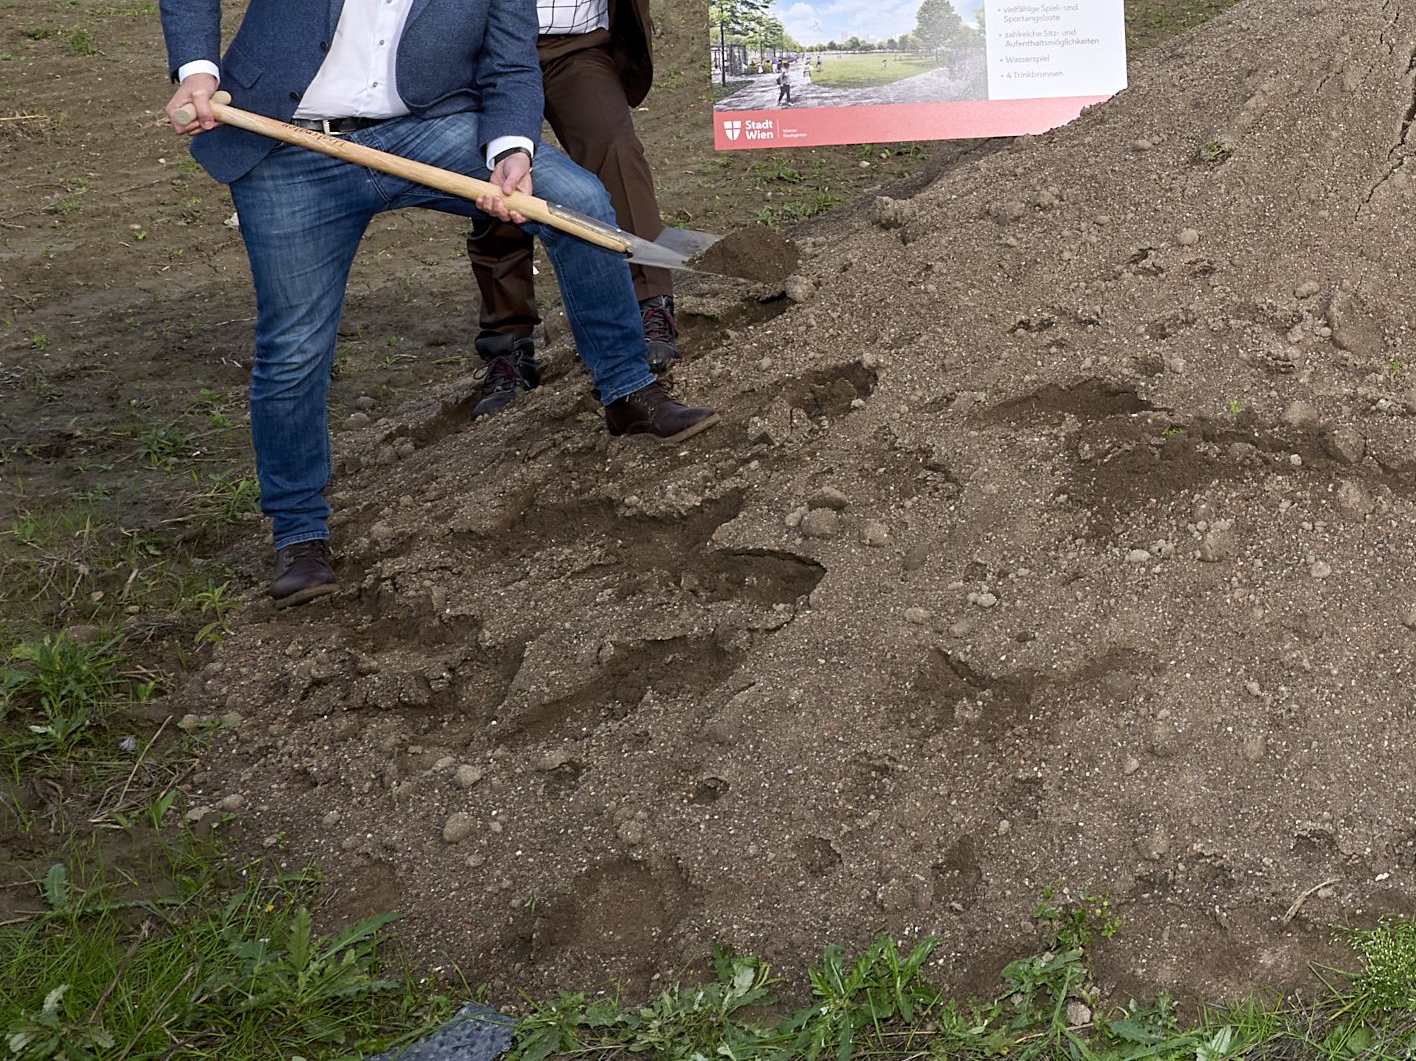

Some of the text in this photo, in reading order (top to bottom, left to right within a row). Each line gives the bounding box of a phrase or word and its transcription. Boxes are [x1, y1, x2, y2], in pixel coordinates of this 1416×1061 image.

[1003, 5, 1040, 15] vielfältige
[1041, 4, 1061, 14] Spiel-
[1003, 14, 1061, 24] Sportangebote
[1004, 29, 1042, 38] zahlreiche
[1043, 29, 1060, 37] Sitz-
[1004, 37, 1100, 48] Aufenthaltsmöglichkeiten
[1005, 55, 1050, 64] Wasserspiel
[1013, 70, 1064, 79] Trinkbrunnen
[745, 119, 773, 130] Stadt
[745, 130, 774, 140] Wien
